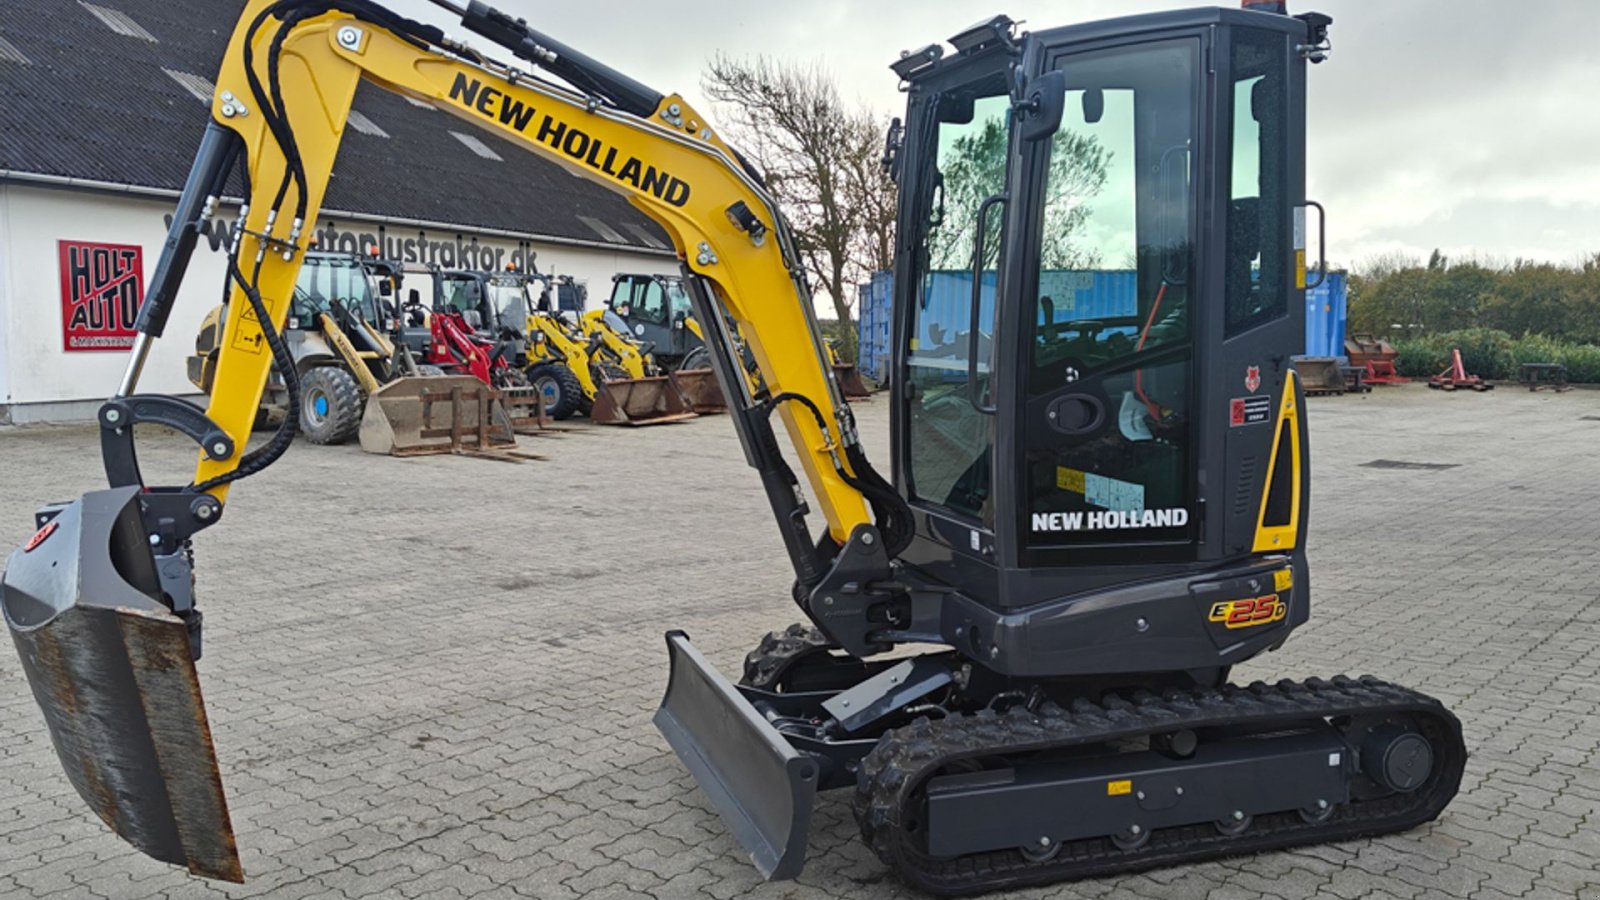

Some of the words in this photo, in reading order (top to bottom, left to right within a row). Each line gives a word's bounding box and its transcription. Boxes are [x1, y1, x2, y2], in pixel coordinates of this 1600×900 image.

[448, 71, 536, 132] NEW
[536, 115, 691, 207] HOLLAND
[68, 274, 139, 330] AUTO
[69, 246, 137, 304] HOLT
[1031, 511, 1083, 532] NEW
[1087, 508, 1189, 530] HOLLAND
